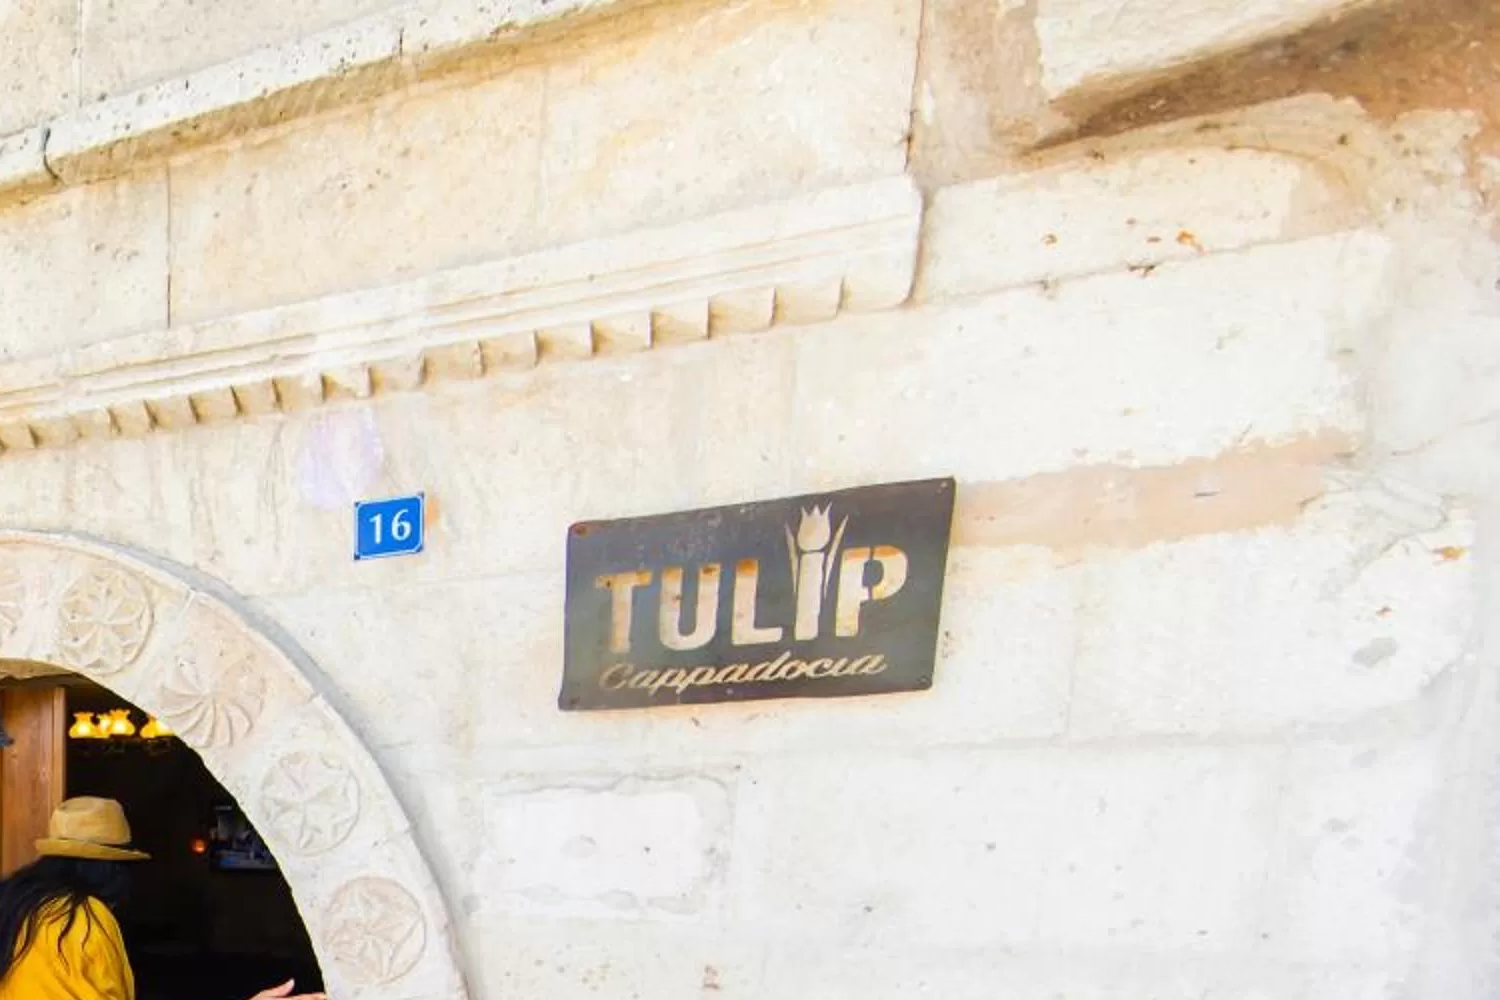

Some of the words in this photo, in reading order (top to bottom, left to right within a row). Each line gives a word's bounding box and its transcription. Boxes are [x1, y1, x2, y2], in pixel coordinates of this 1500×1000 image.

[368, 508, 412, 545] 16
[595, 546, 908, 654] TULIP
[599, 650, 888, 696] Cappadocia
